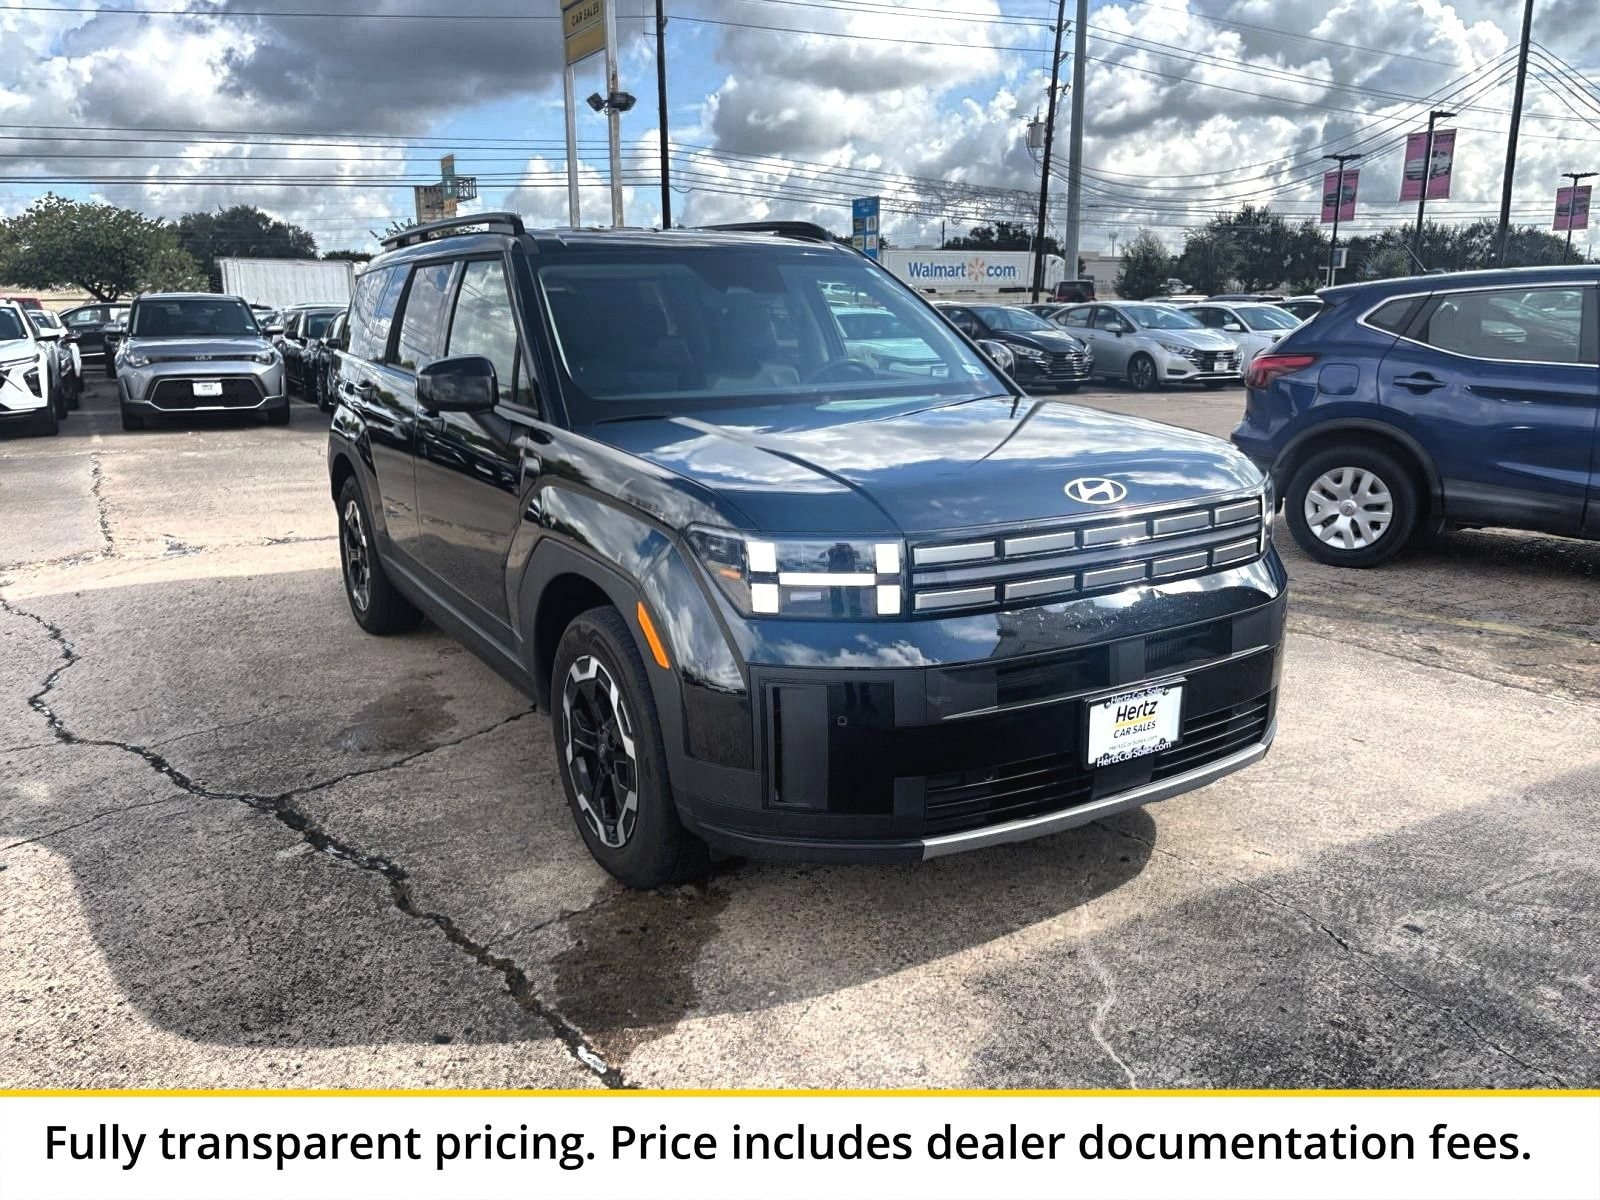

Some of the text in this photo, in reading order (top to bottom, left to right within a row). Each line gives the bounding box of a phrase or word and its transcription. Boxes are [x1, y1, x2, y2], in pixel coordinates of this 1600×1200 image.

[572, 2, 599, 26] CAR SALES
[908, 262, 966, 278] Walmart
[1115, 701, 1158, 723] Hertz
[1113, 720, 1156, 739] CAR SALES
[1096, 741, 1172, 768] HertzCarSales.com
